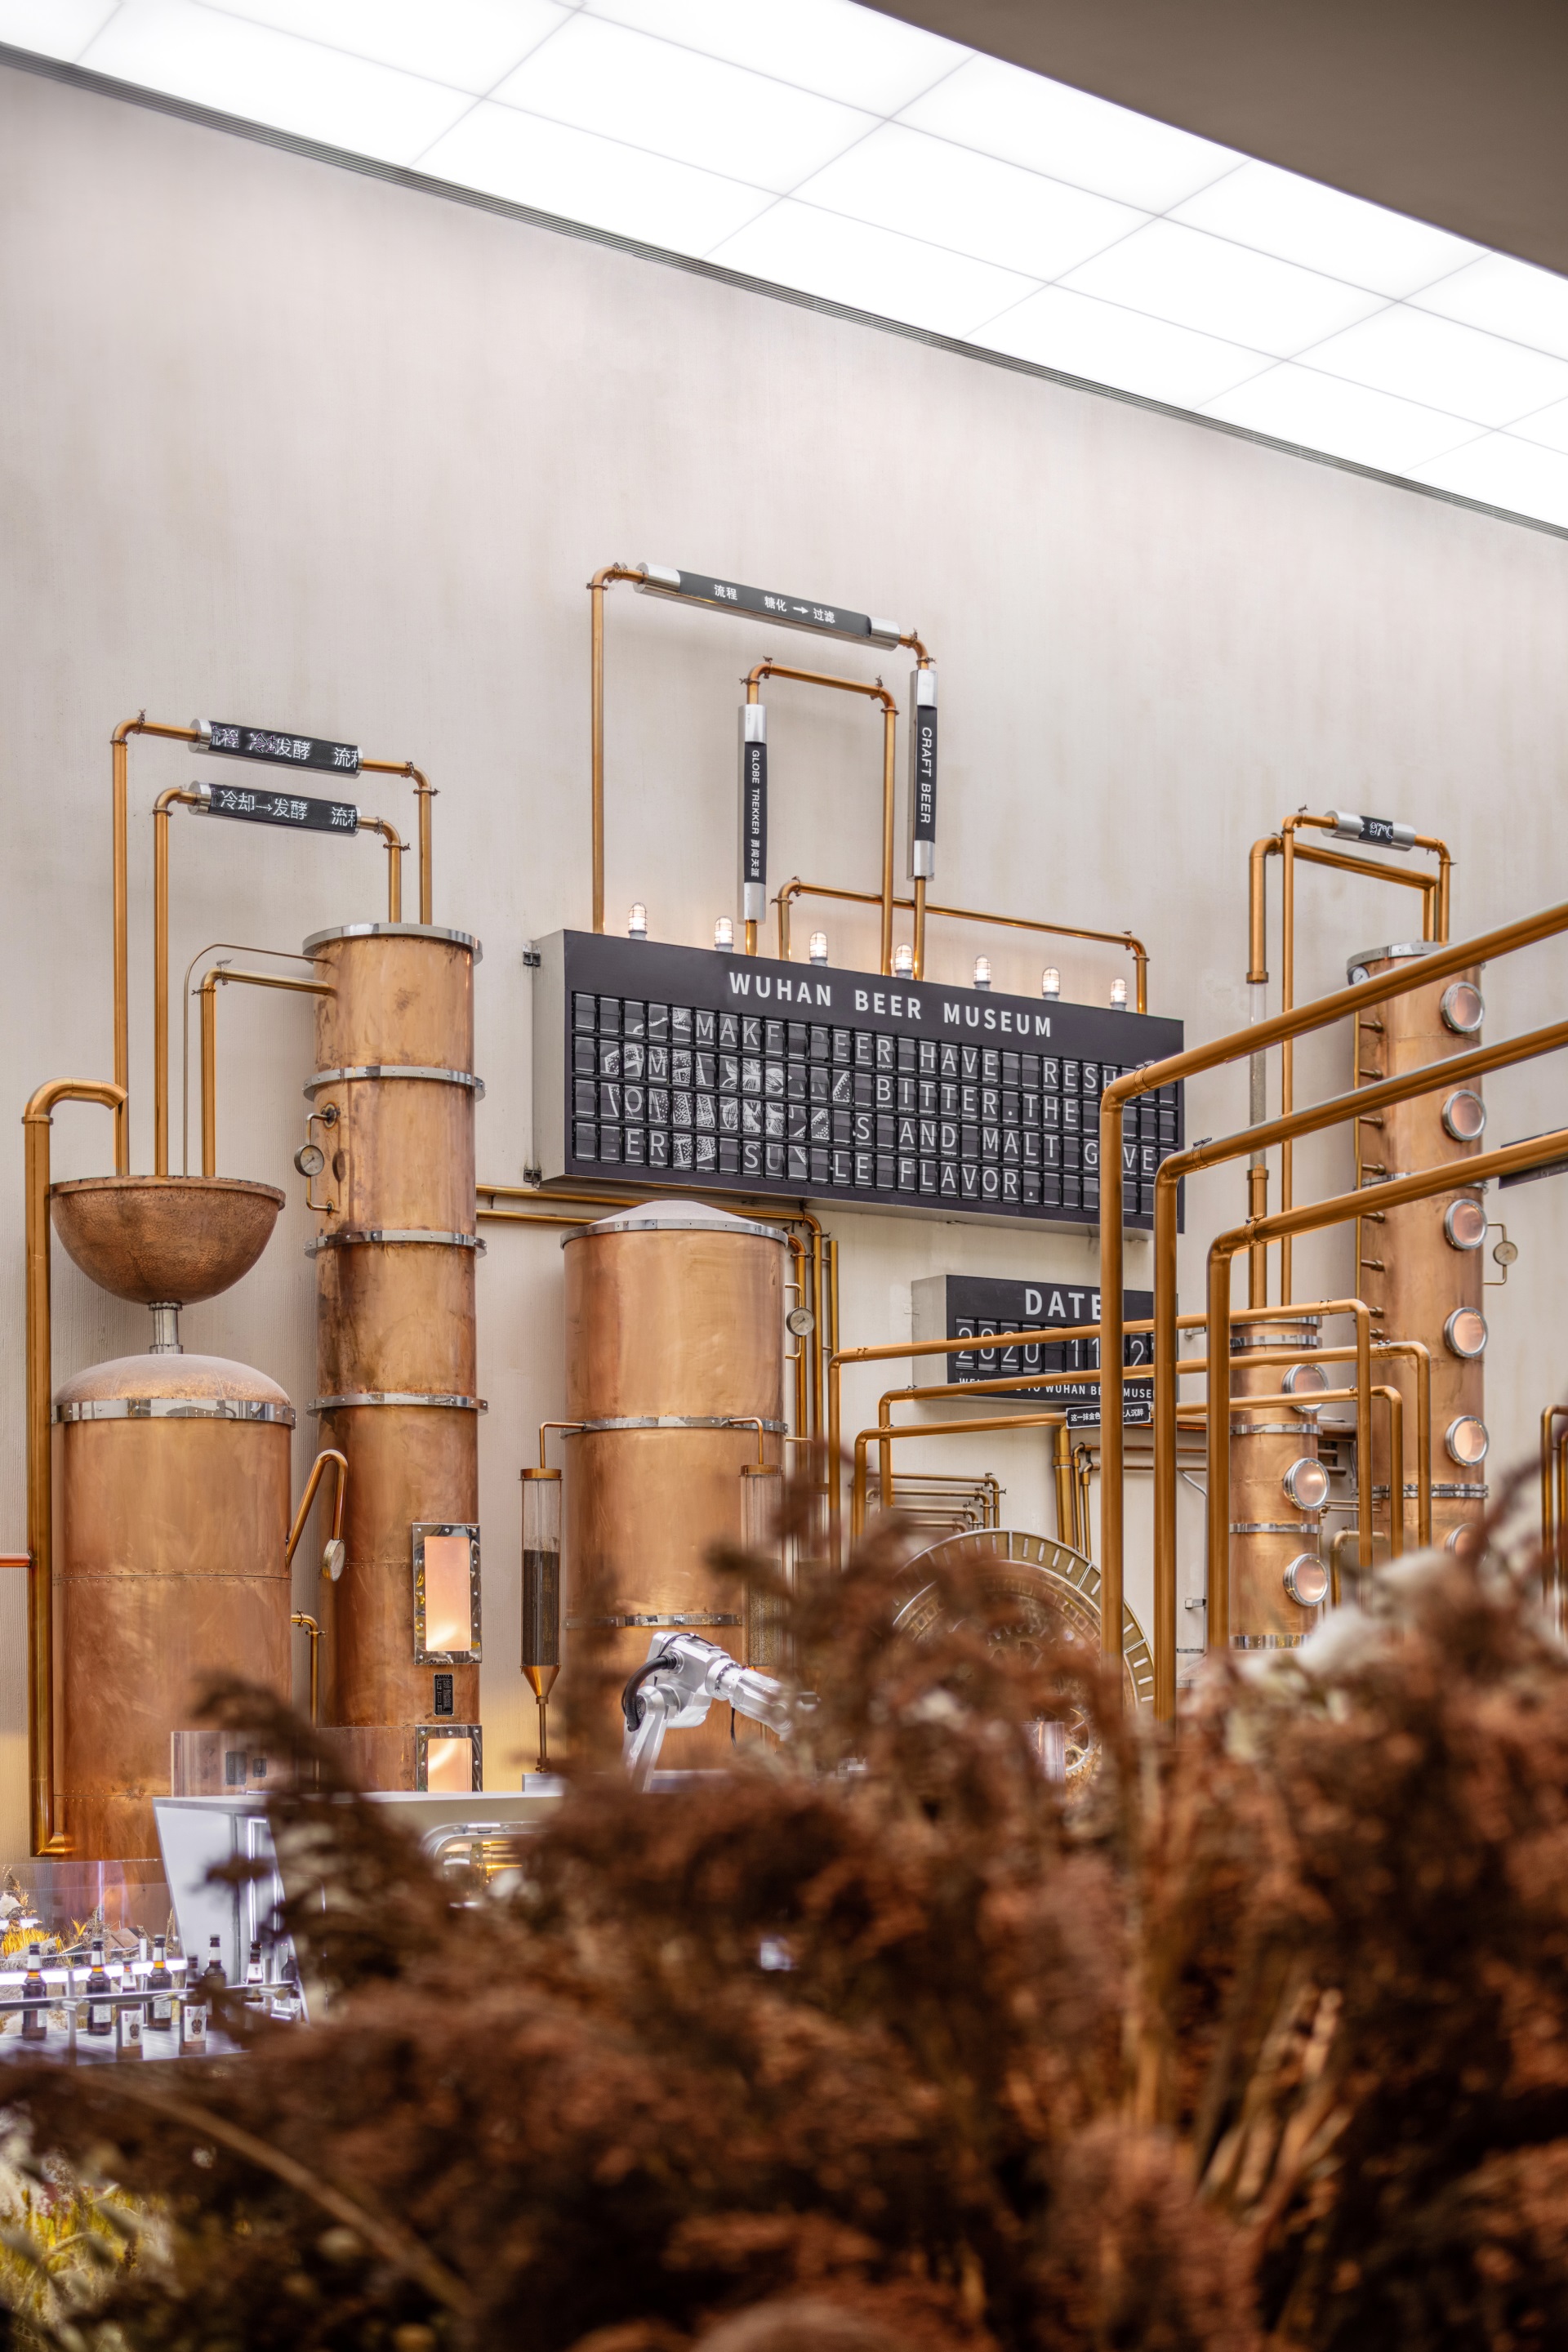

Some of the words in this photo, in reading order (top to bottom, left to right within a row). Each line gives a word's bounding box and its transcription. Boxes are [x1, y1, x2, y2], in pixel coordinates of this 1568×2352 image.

[714, 584, 738, 600] 流程
[764, 595, 787, 612] 糖化
[813, 608, 836, 624] 过滤
[751, 750, 760, 785] GLOBE
[921, 727, 933, 777] CRAFT
[751, 787, 760, 835] TREKKER
[920, 782, 932, 824] BEER
[728, 972, 831, 1007] WUHAN
[855, 990, 922, 1020] BEER
[943, 1002, 1052, 1038] MUSEUM
[920, 1045, 997, 1077] HAVE
[899, 1121, 956, 1148] AND
[982, 1129, 1058, 1159] MALT
[1084, 1142, 1155, 1172] GVE
[901, 1160, 1033, 1197] FLAVOR.
[1025, 1288, 1101, 1321] DATE
[1045, 1383, 1085, 1395] WUHAN
[1123, 1388, 1155, 1399] MUSE
